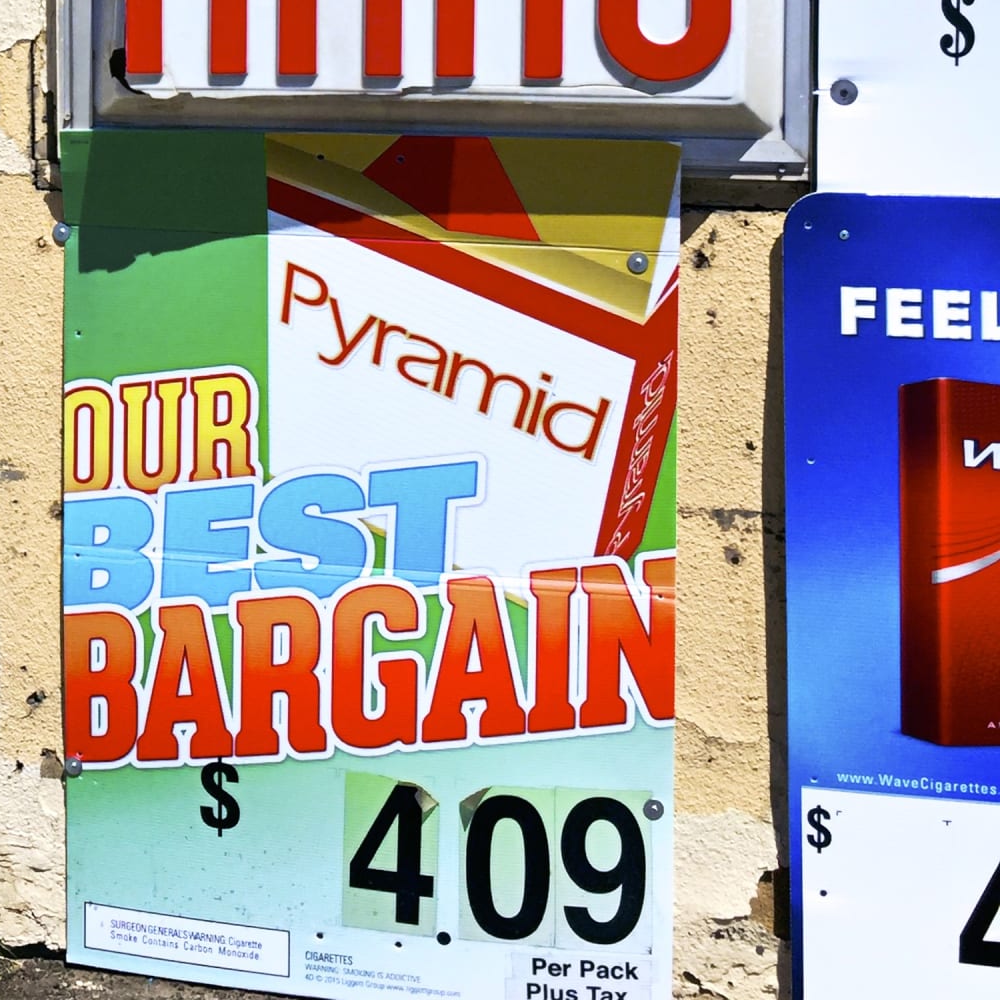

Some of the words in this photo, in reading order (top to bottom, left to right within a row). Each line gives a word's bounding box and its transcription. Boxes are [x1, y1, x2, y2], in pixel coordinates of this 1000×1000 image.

[280, 262, 612, 462] Pyramid
[64, 373, 256, 494] OUR
[63, 460, 480, 607] BEST
[63, 557, 676, 763] BARGAIN
[110, 919, 148, 934] SURGEON
[228, 936, 263, 951] Cigarette
[110, 930, 138, 944] Smoke
[142, 936, 179, 950] Contains
[183, 941, 213, 954] Carbon
[305, 950, 353, 966] CIGARETTES
[532, 957, 572, 977] Per
[580, 959, 639, 980] Pack
[526, 982, 579, 1000] Plus
[585, 985, 628, 1000] Tax
